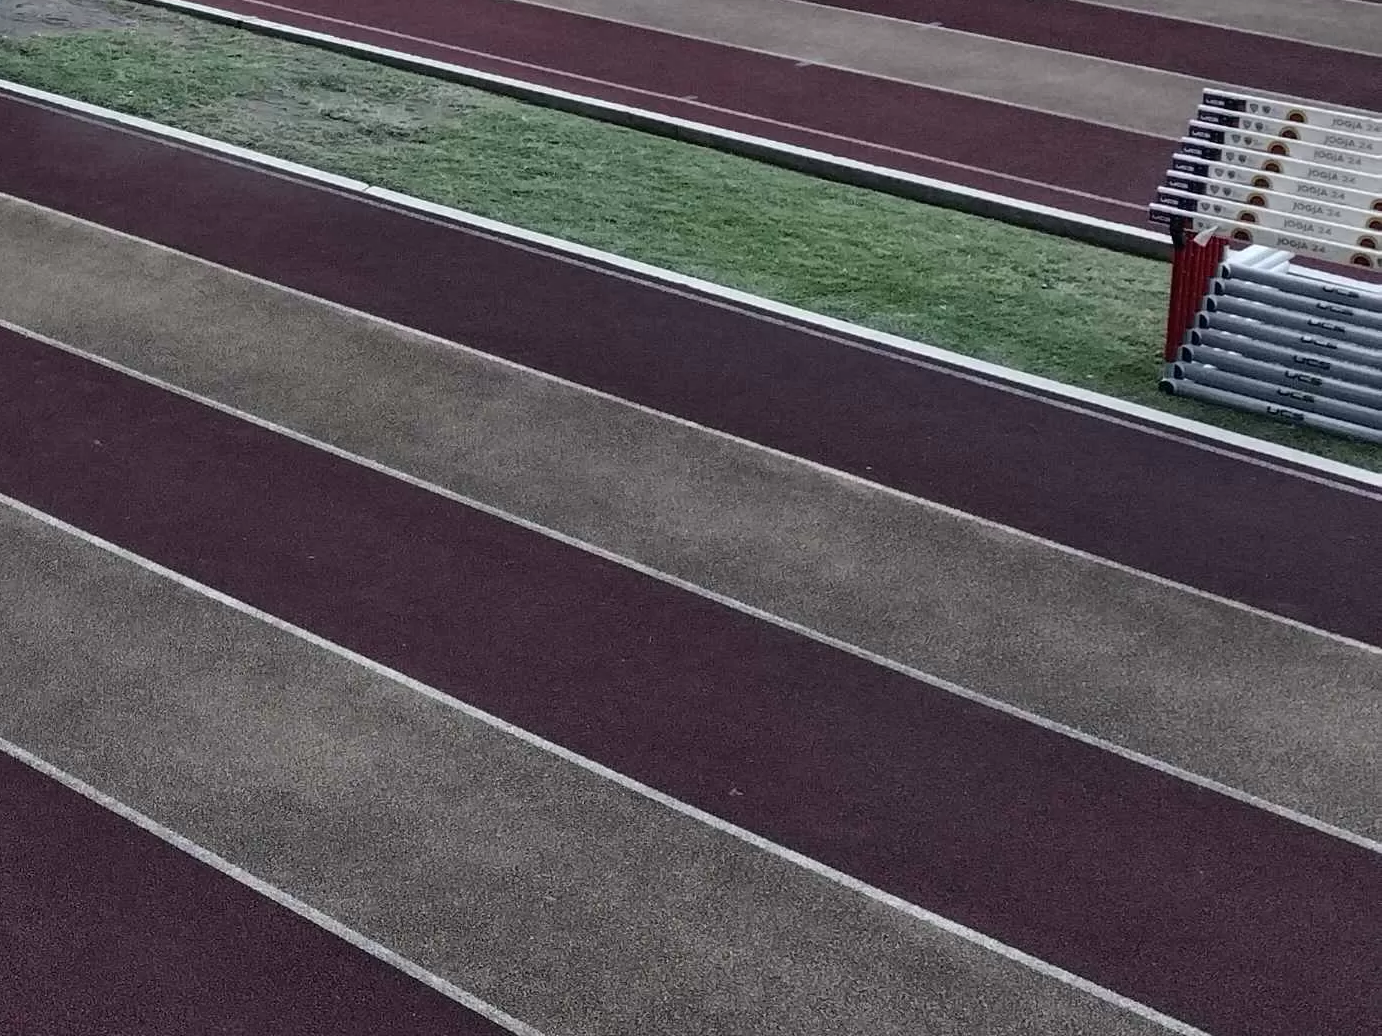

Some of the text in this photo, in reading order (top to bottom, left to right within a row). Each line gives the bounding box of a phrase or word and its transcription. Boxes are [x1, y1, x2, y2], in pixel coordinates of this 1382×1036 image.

[1332, 119, 1363, 130] JOGJA
[1324, 135, 1355, 147] JOGJA
[1314, 150, 1344, 163] JOGJA
[1307, 168, 1338, 181] JOGJA
[1297, 184, 1328, 197] JOGJA
[1292, 202, 1324, 214] JOGJA
[1283, 219, 1315, 232] JOGJA
[1276, 237, 1308, 250] JOGJA
